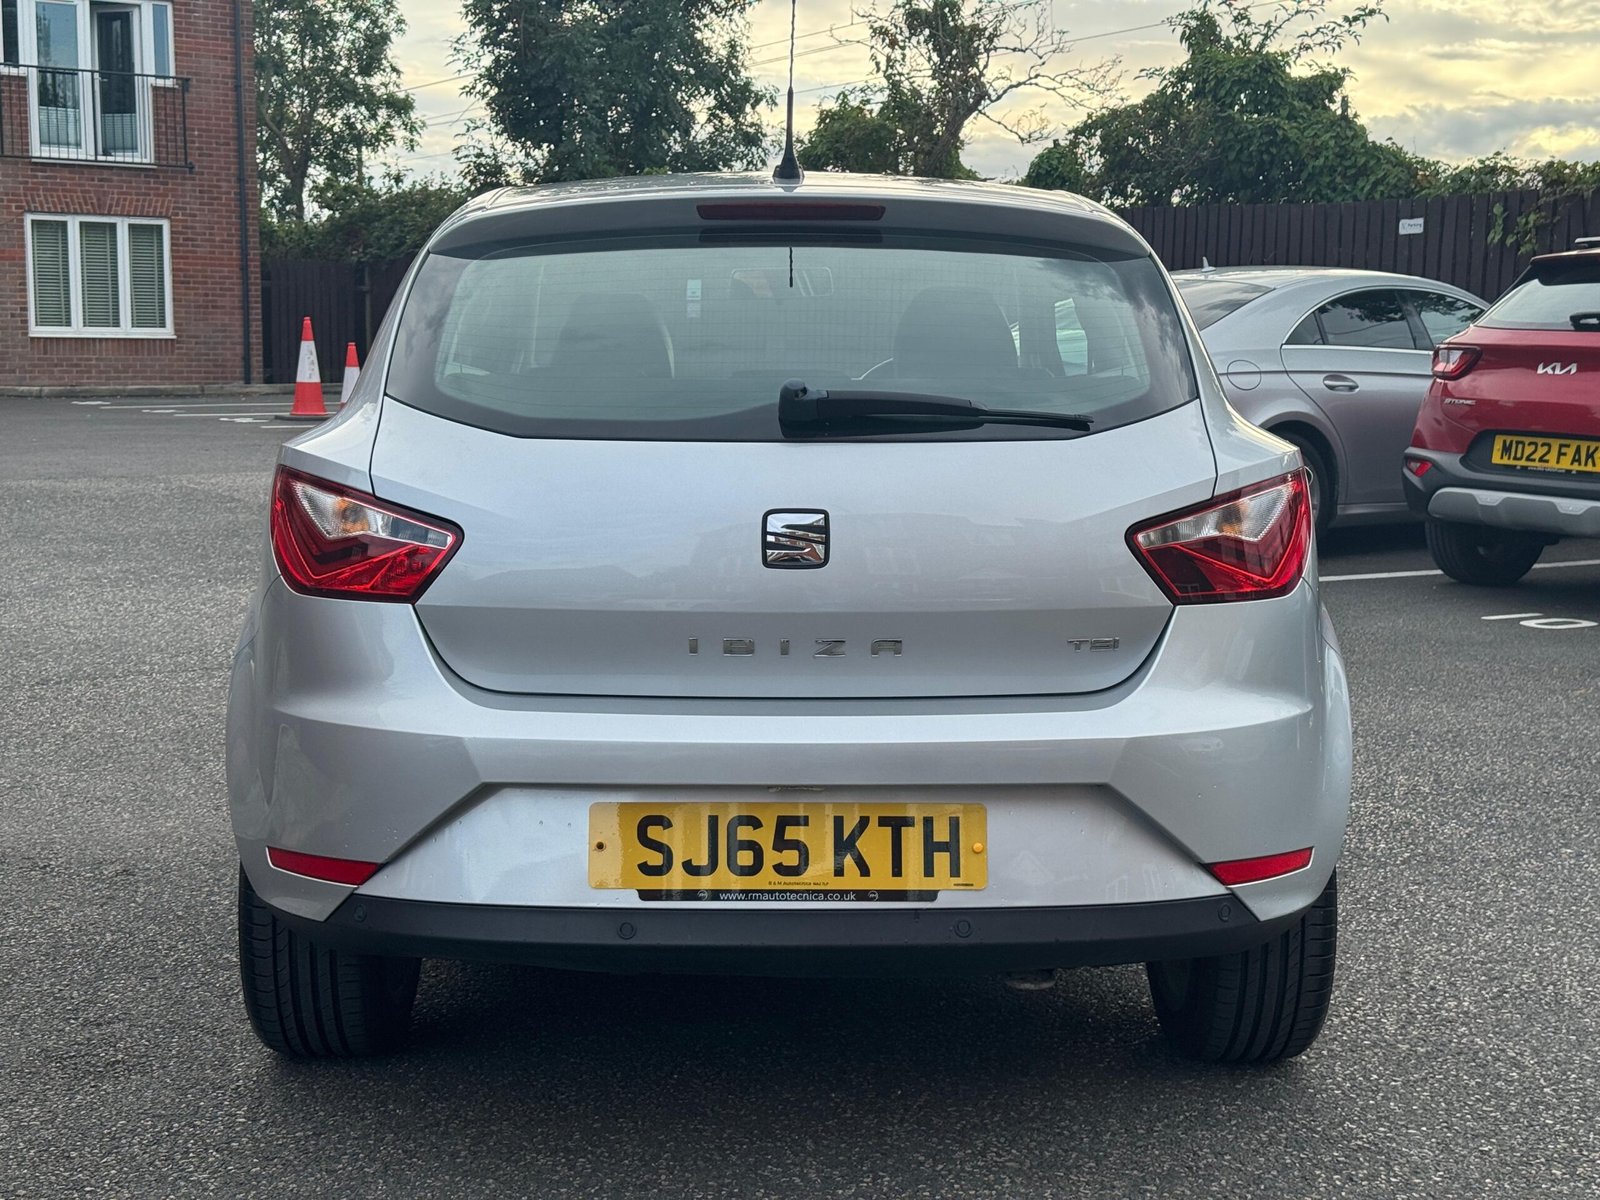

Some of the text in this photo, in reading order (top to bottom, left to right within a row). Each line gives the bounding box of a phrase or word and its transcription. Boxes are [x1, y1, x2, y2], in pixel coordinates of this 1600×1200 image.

[1537, 362, 1577, 375] KIA
[1500, 439, 1599, 467] MD22 FAK
[688, 638, 902, 657] IBIZA
[1067, 637, 1120, 652] TSI
[636, 814, 961, 878] SJ65 KTH
[719, 890, 857, 901] www.rmautotecnica.co.uk
